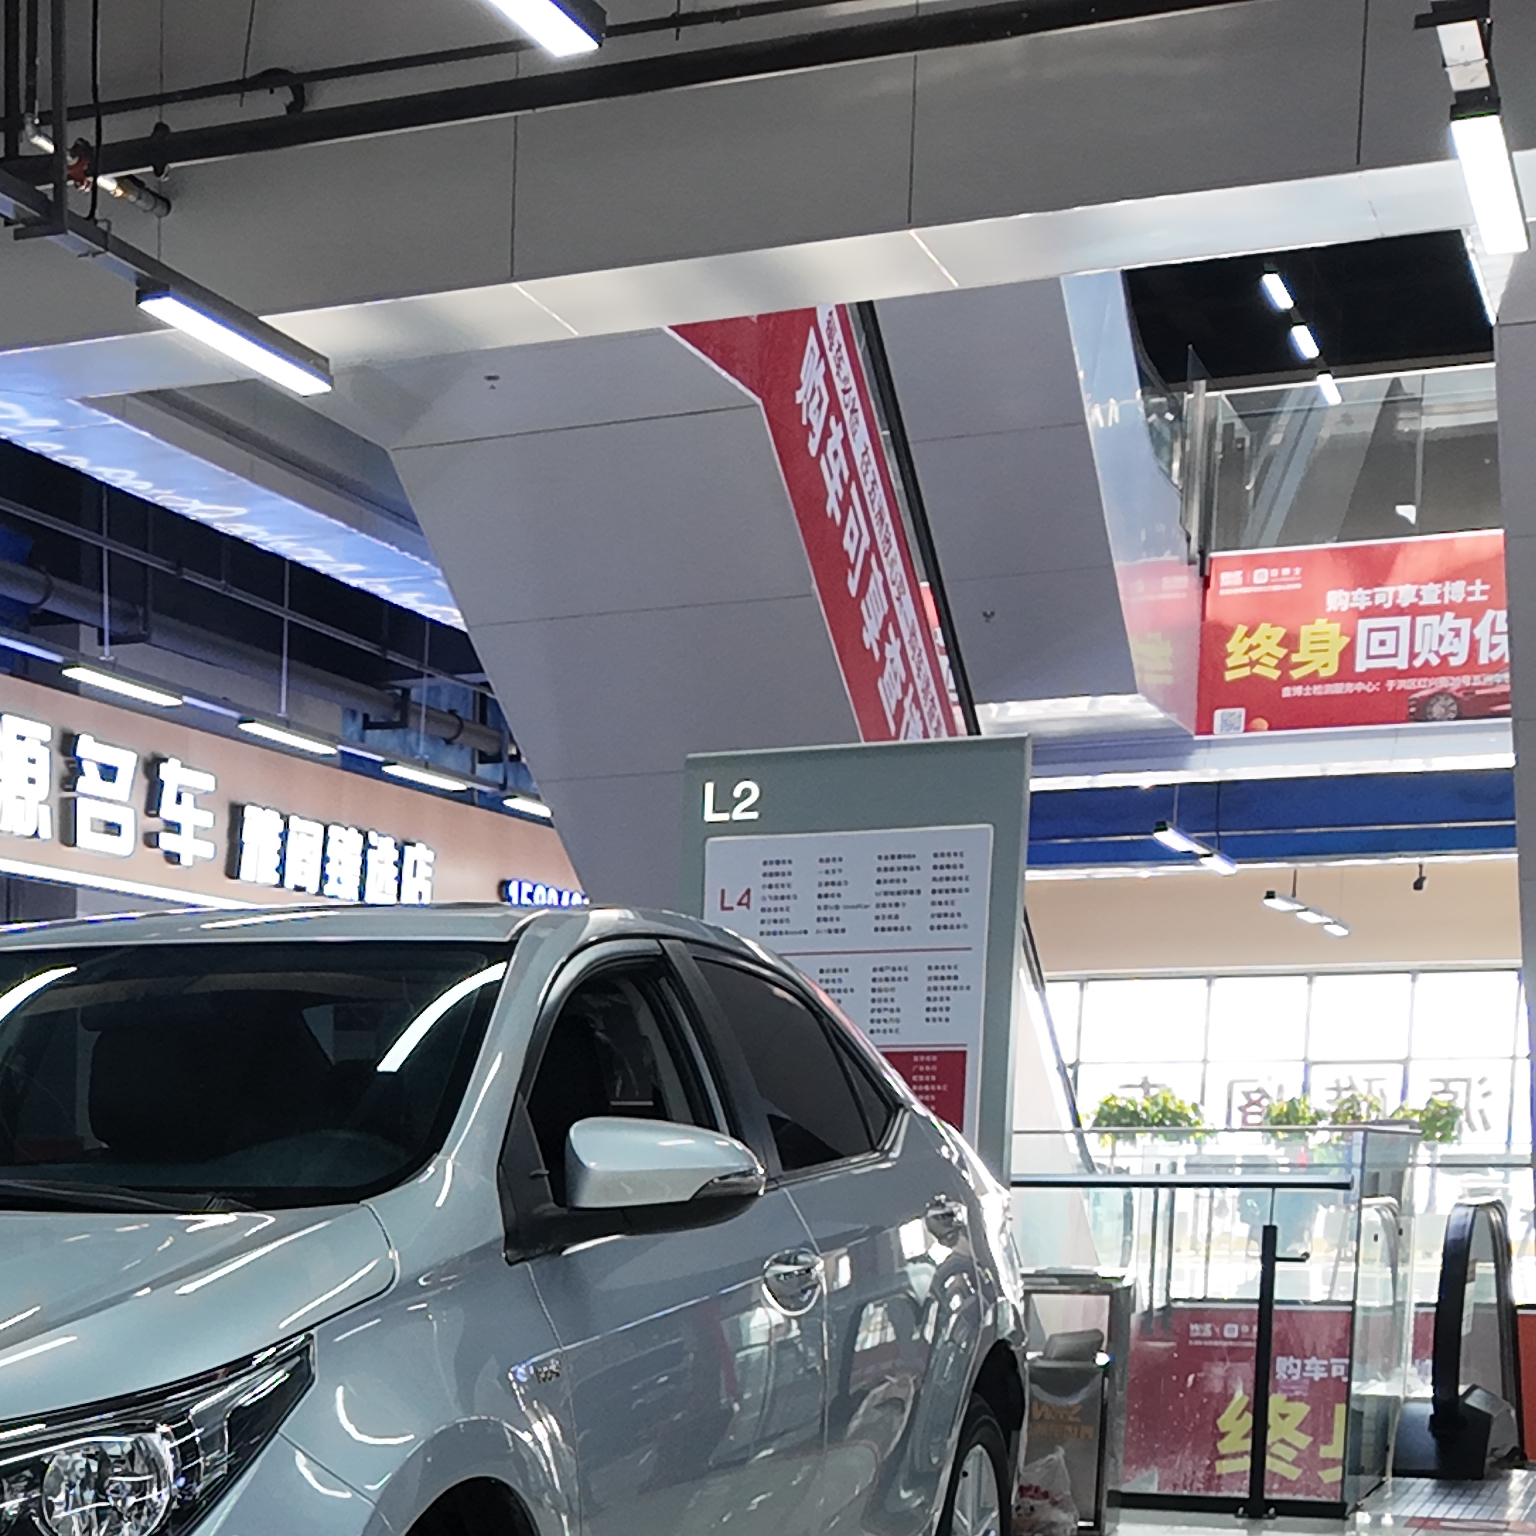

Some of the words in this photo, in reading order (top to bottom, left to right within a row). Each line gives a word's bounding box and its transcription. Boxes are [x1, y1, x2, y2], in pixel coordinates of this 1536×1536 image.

[1325, 578, 1491, 612] 购车可享查博士
[703, 780, 761, 823] L2
[720, 887, 752, 912] L4
